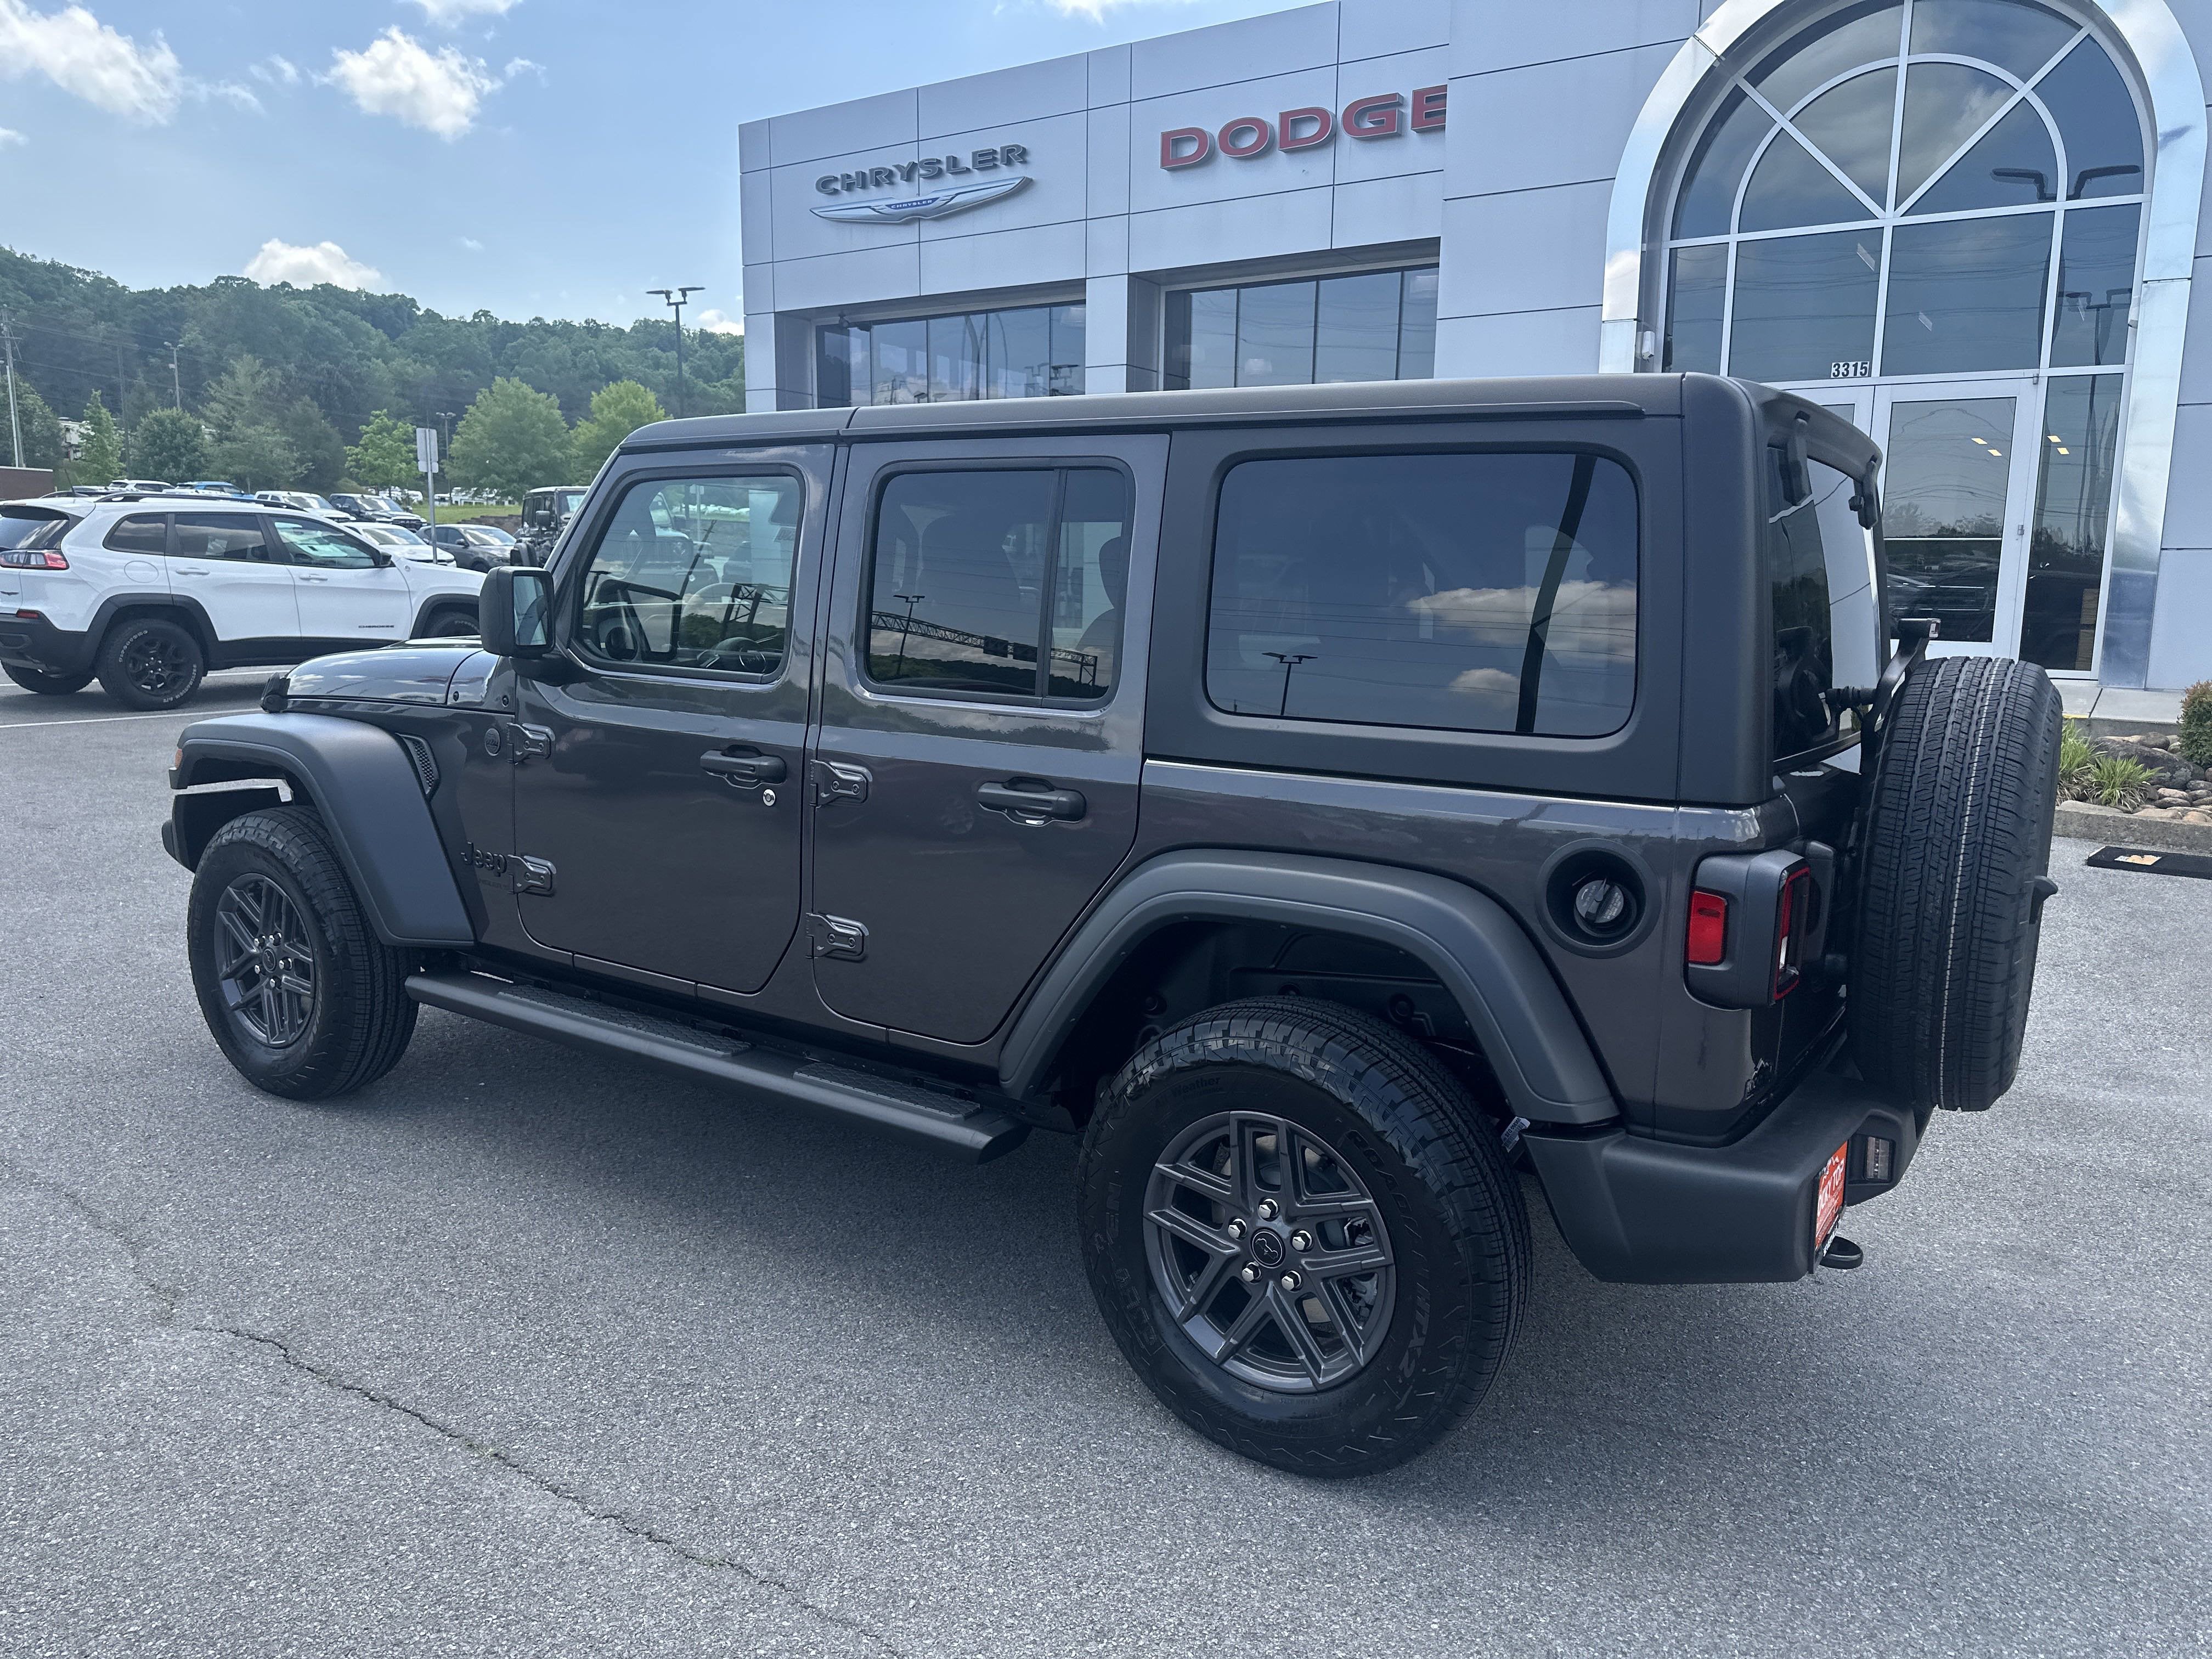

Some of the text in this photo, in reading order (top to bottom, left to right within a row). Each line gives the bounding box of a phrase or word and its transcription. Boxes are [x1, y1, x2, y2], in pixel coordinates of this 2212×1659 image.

[1161, 84, 1447, 171] DODGE
[816, 144, 1026, 194] CHRYSLER
[891, 200, 933, 208] CHRYSLER
[1832, 362, 1869, 378] 3315
[460, 841, 507, 877] Jeep
